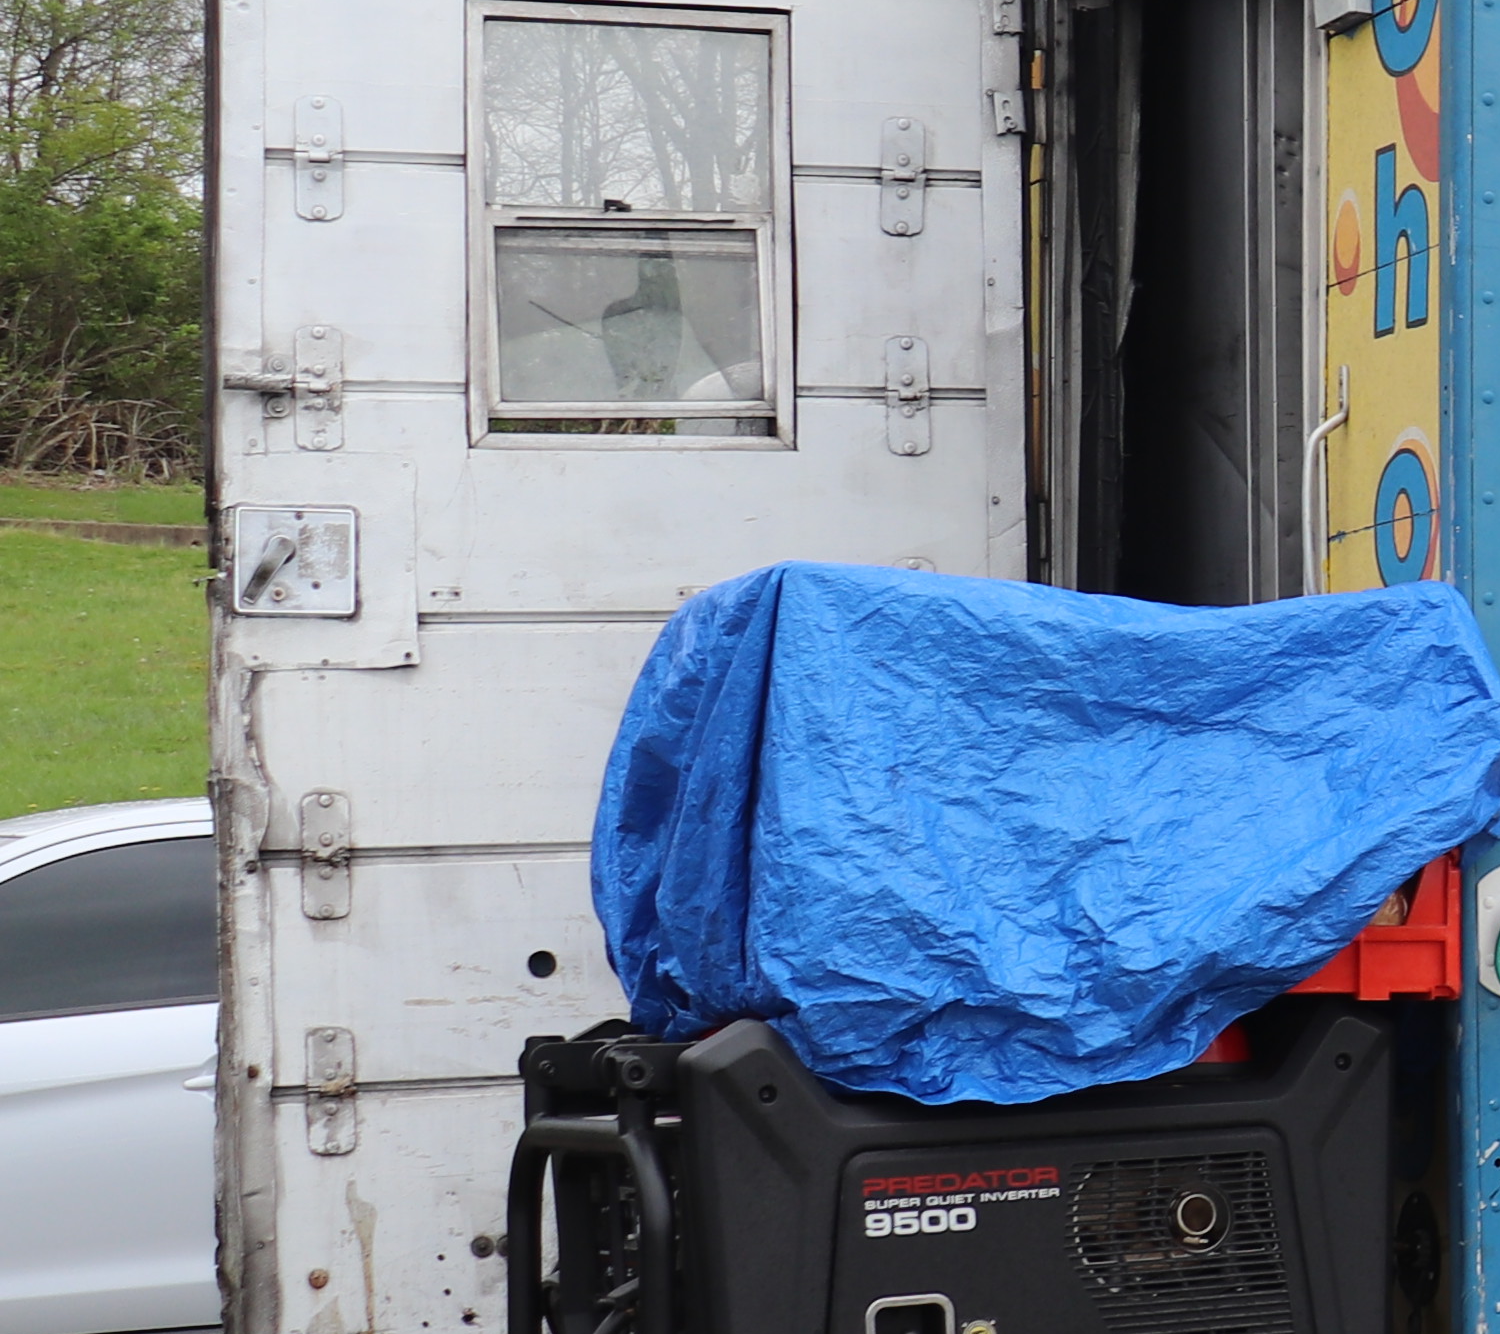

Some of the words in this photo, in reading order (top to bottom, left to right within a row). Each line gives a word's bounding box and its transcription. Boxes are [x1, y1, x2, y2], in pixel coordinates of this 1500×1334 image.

[862, 1166, 1059, 1196] PREDATOR
[864, 1197, 921, 1211] SUPER
[926, 1193, 975, 1207] QUIET
[980, 1187, 1060, 1203] INVERTER
[864, 1207, 977, 1238] 9500
